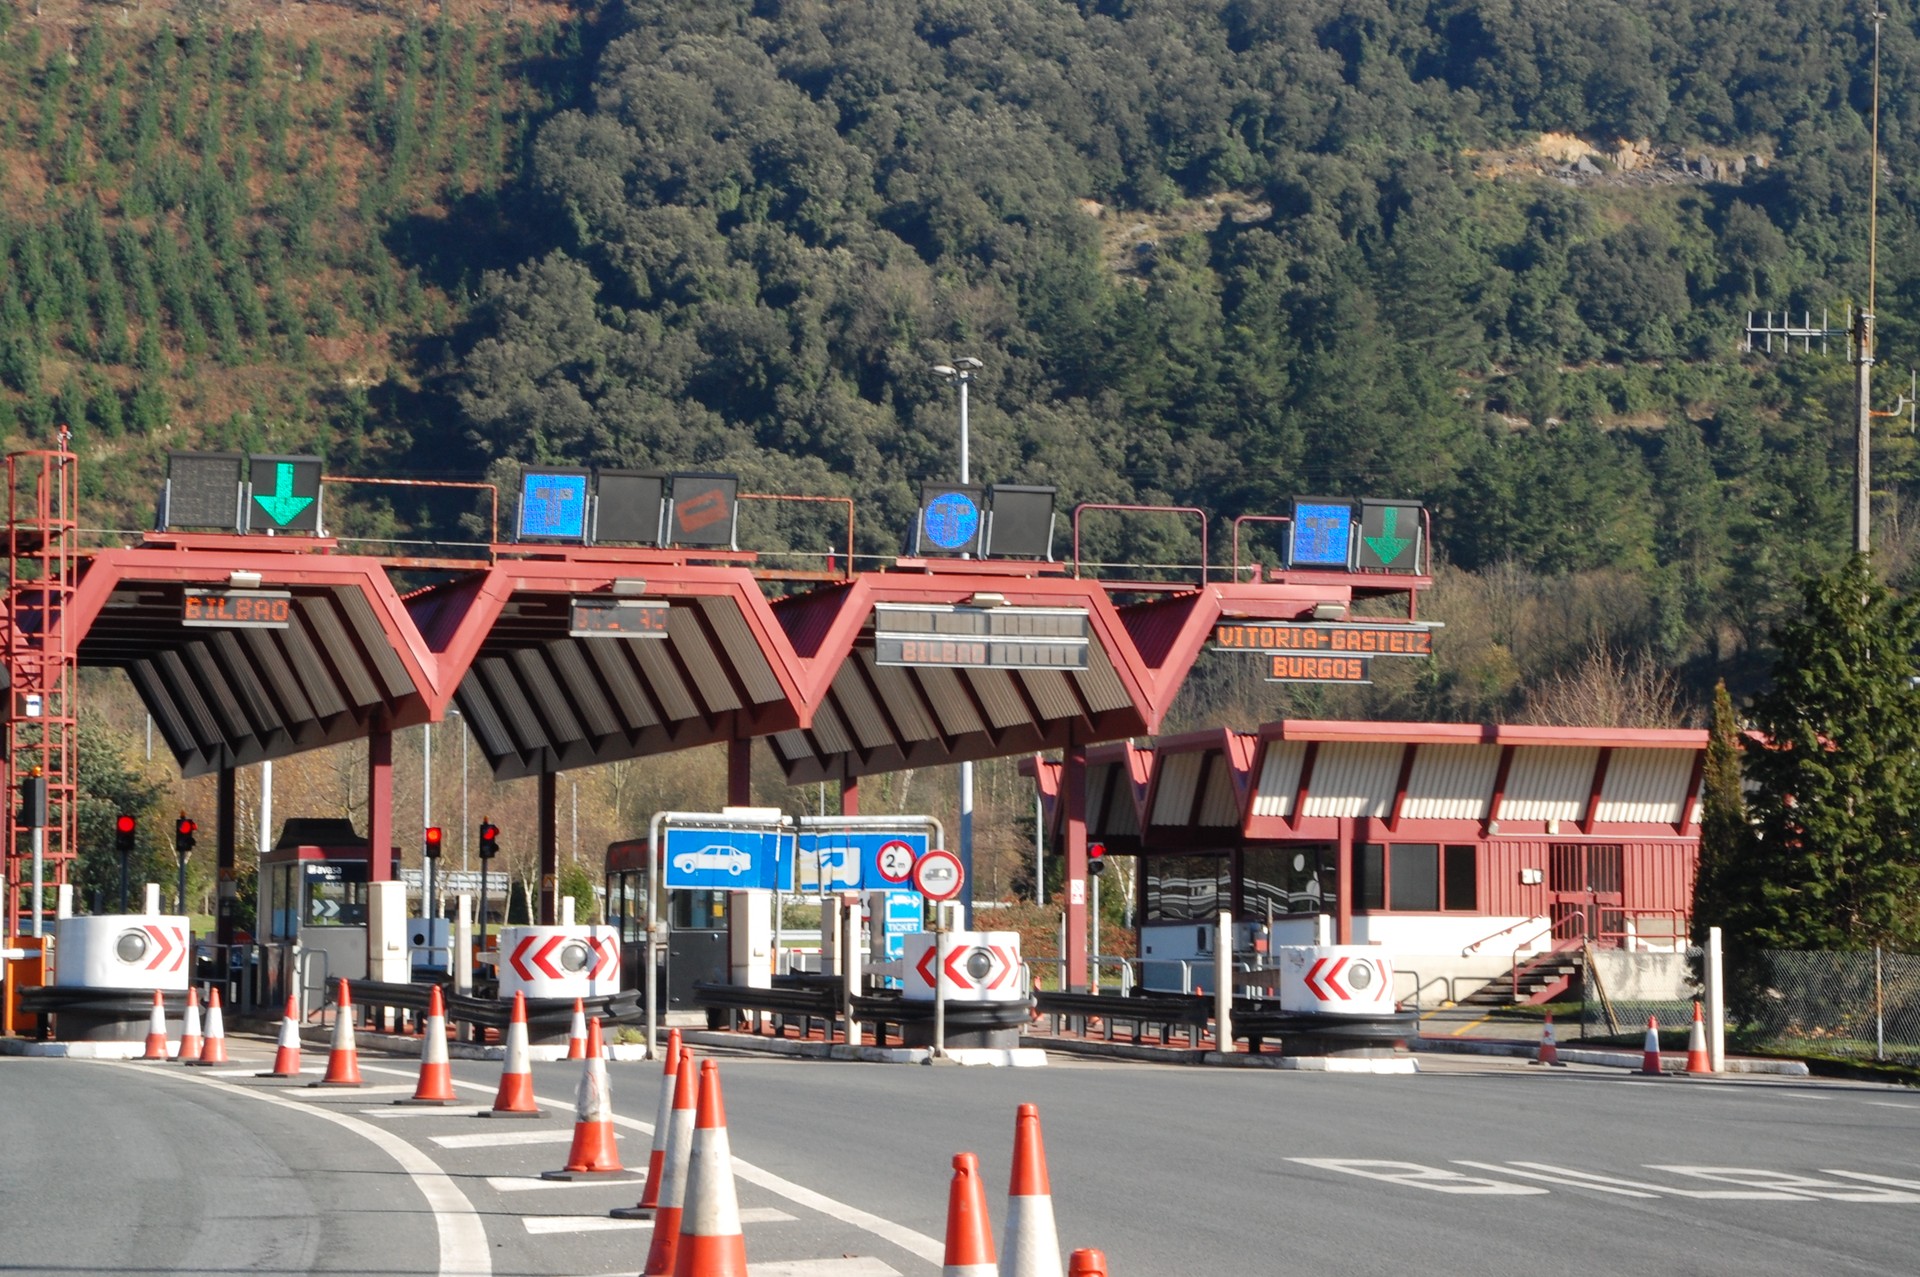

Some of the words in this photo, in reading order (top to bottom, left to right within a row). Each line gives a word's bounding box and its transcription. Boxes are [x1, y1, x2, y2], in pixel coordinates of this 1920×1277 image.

[185, 596, 288, 621] BILBAO
[1218, 626, 1431, 654] VITORIA-GASTEIZ
[902, 641, 986, 664] BILBAO
[1273, 656, 1362, 679] BURGOS
[885, 854, 895, 868] 2
[887, 923, 918, 931] TICKET
